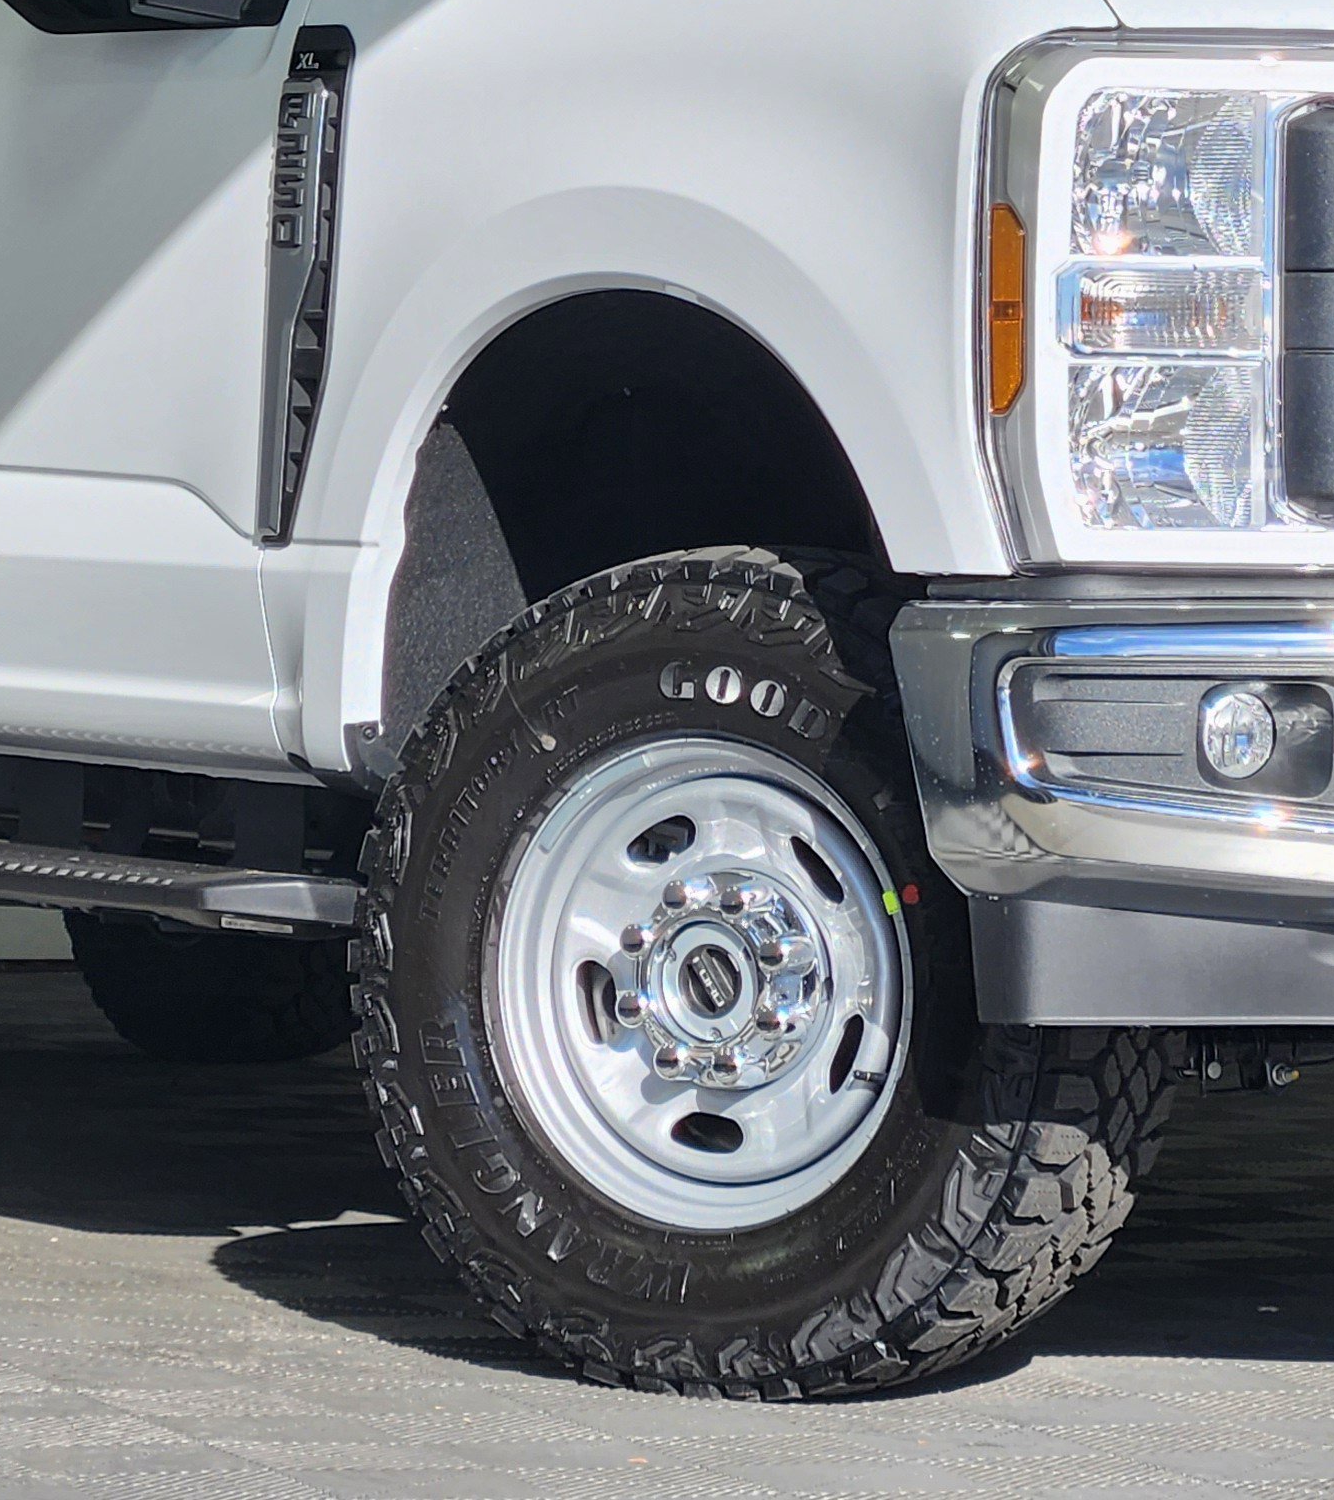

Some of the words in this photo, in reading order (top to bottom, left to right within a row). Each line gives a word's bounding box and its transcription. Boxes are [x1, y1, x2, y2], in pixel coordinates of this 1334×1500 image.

[295, 52, 320, 70] XL
[658, 658, 828, 740] GOOD
[418, 1018, 692, 1304] WRANGLER
